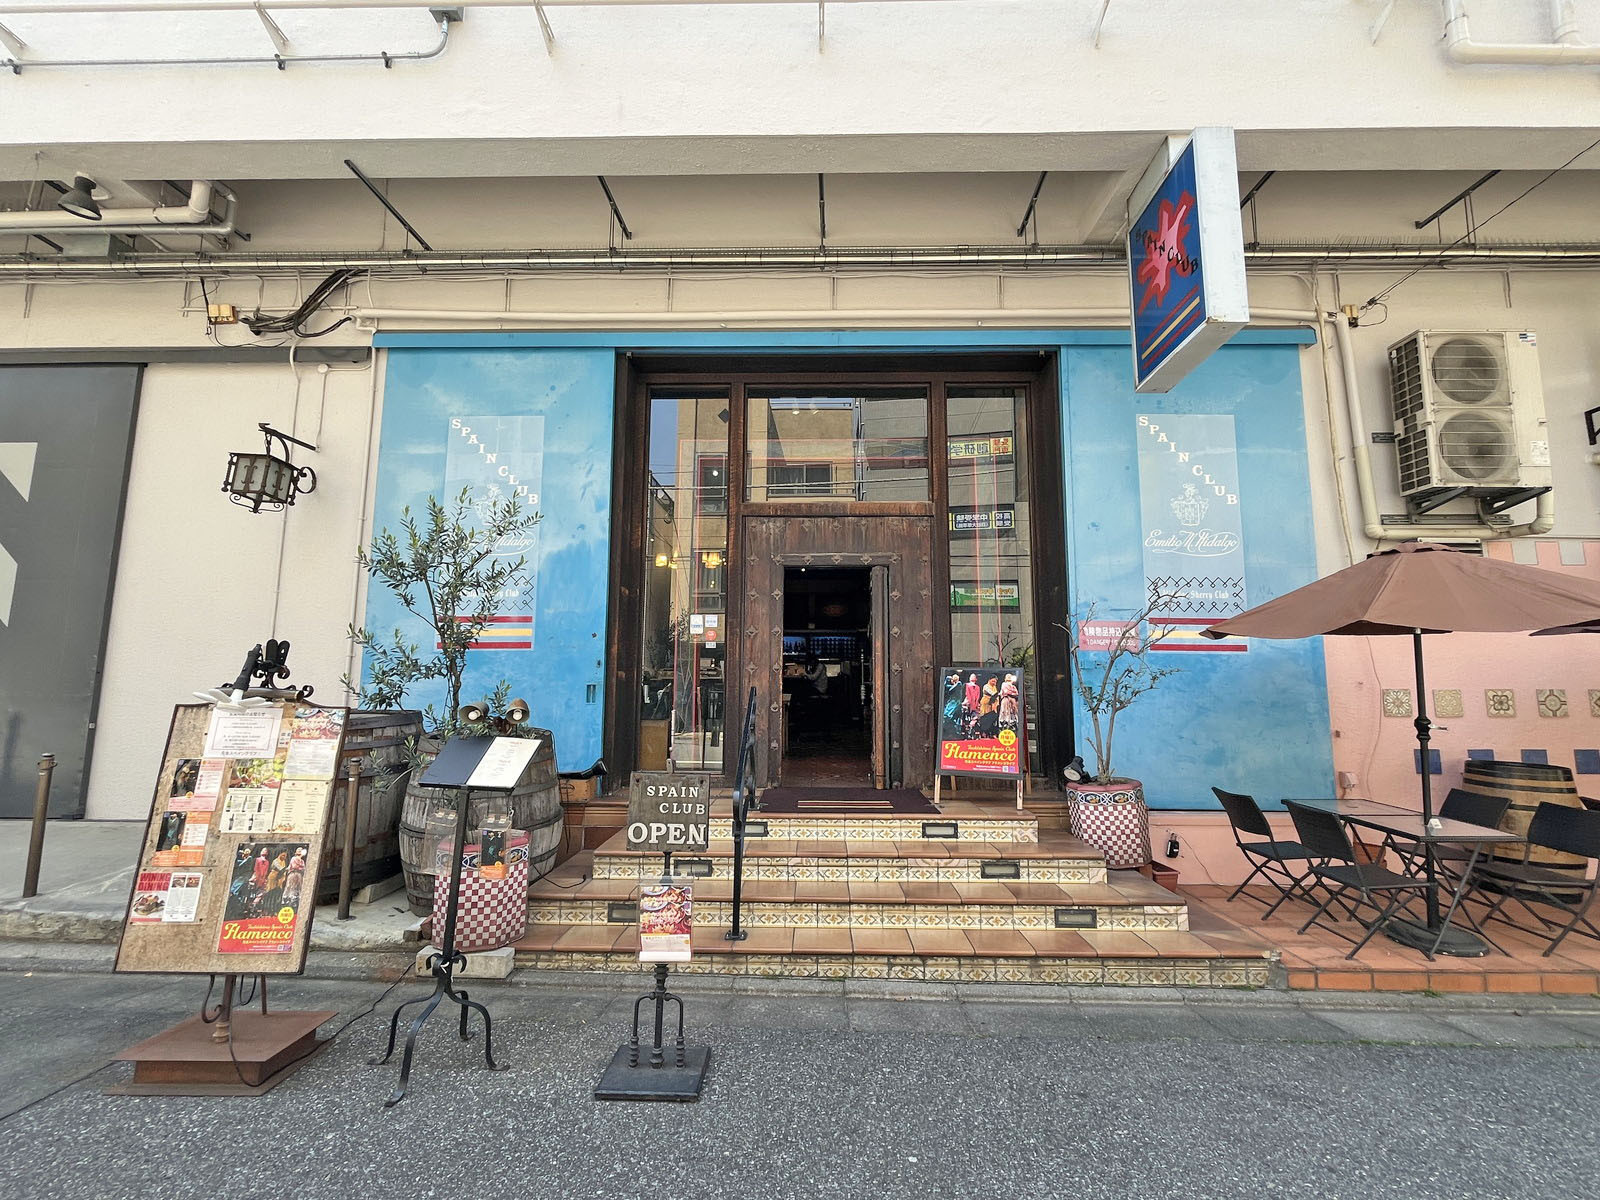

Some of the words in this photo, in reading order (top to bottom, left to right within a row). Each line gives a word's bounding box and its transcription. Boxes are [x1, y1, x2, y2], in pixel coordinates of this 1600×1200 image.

[1135, 228, 1167, 258] SPAIN
[1167, 245, 1199, 276] CLUB
[451, 418, 497, 464] SPAIN
[498, 465, 538, 504] CLUB
[1138, 415, 1190, 463] SPAIN
[1191, 464, 1238, 505] CLUB
[1144, 529, 1182, 548] Emilio
[1195, 529, 1237, 552] Hidalgo
[944, 742, 1017, 761] Flamenco
[646, 785, 700, 798] SPAIN
[659, 802, 706, 815] CLUB
[627, 822, 707, 846] OPEN
[223, 922, 293, 940] Flamenco
